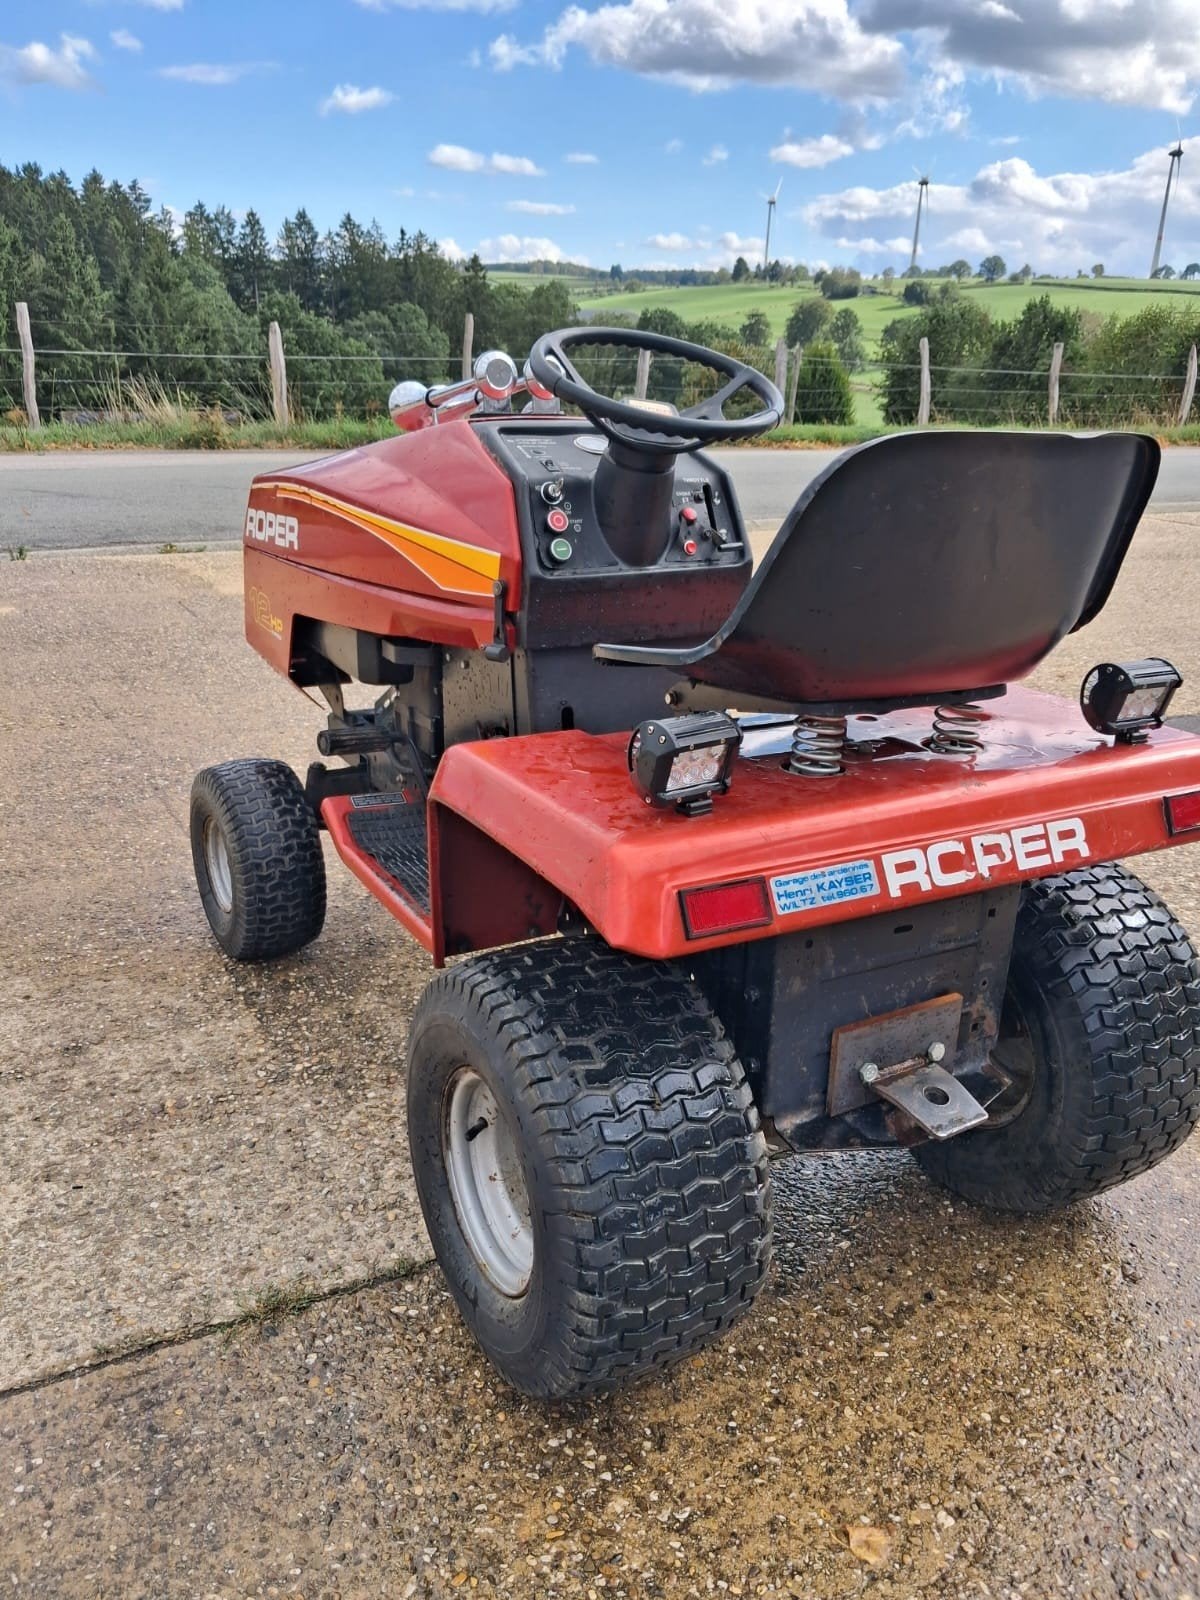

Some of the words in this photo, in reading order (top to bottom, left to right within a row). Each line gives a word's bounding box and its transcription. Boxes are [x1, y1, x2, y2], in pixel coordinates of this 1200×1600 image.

[246, 508, 299, 550] ROPER
[775, 875, 809, 888] Garage
[810, 871, 827, 880] des
[828, 863, 870, 877] ardennes
[777, 887, 813, 901] Henri
[816, 872, 873, 893] KAYSER
[779, 897, 817, 912] WILTZ
